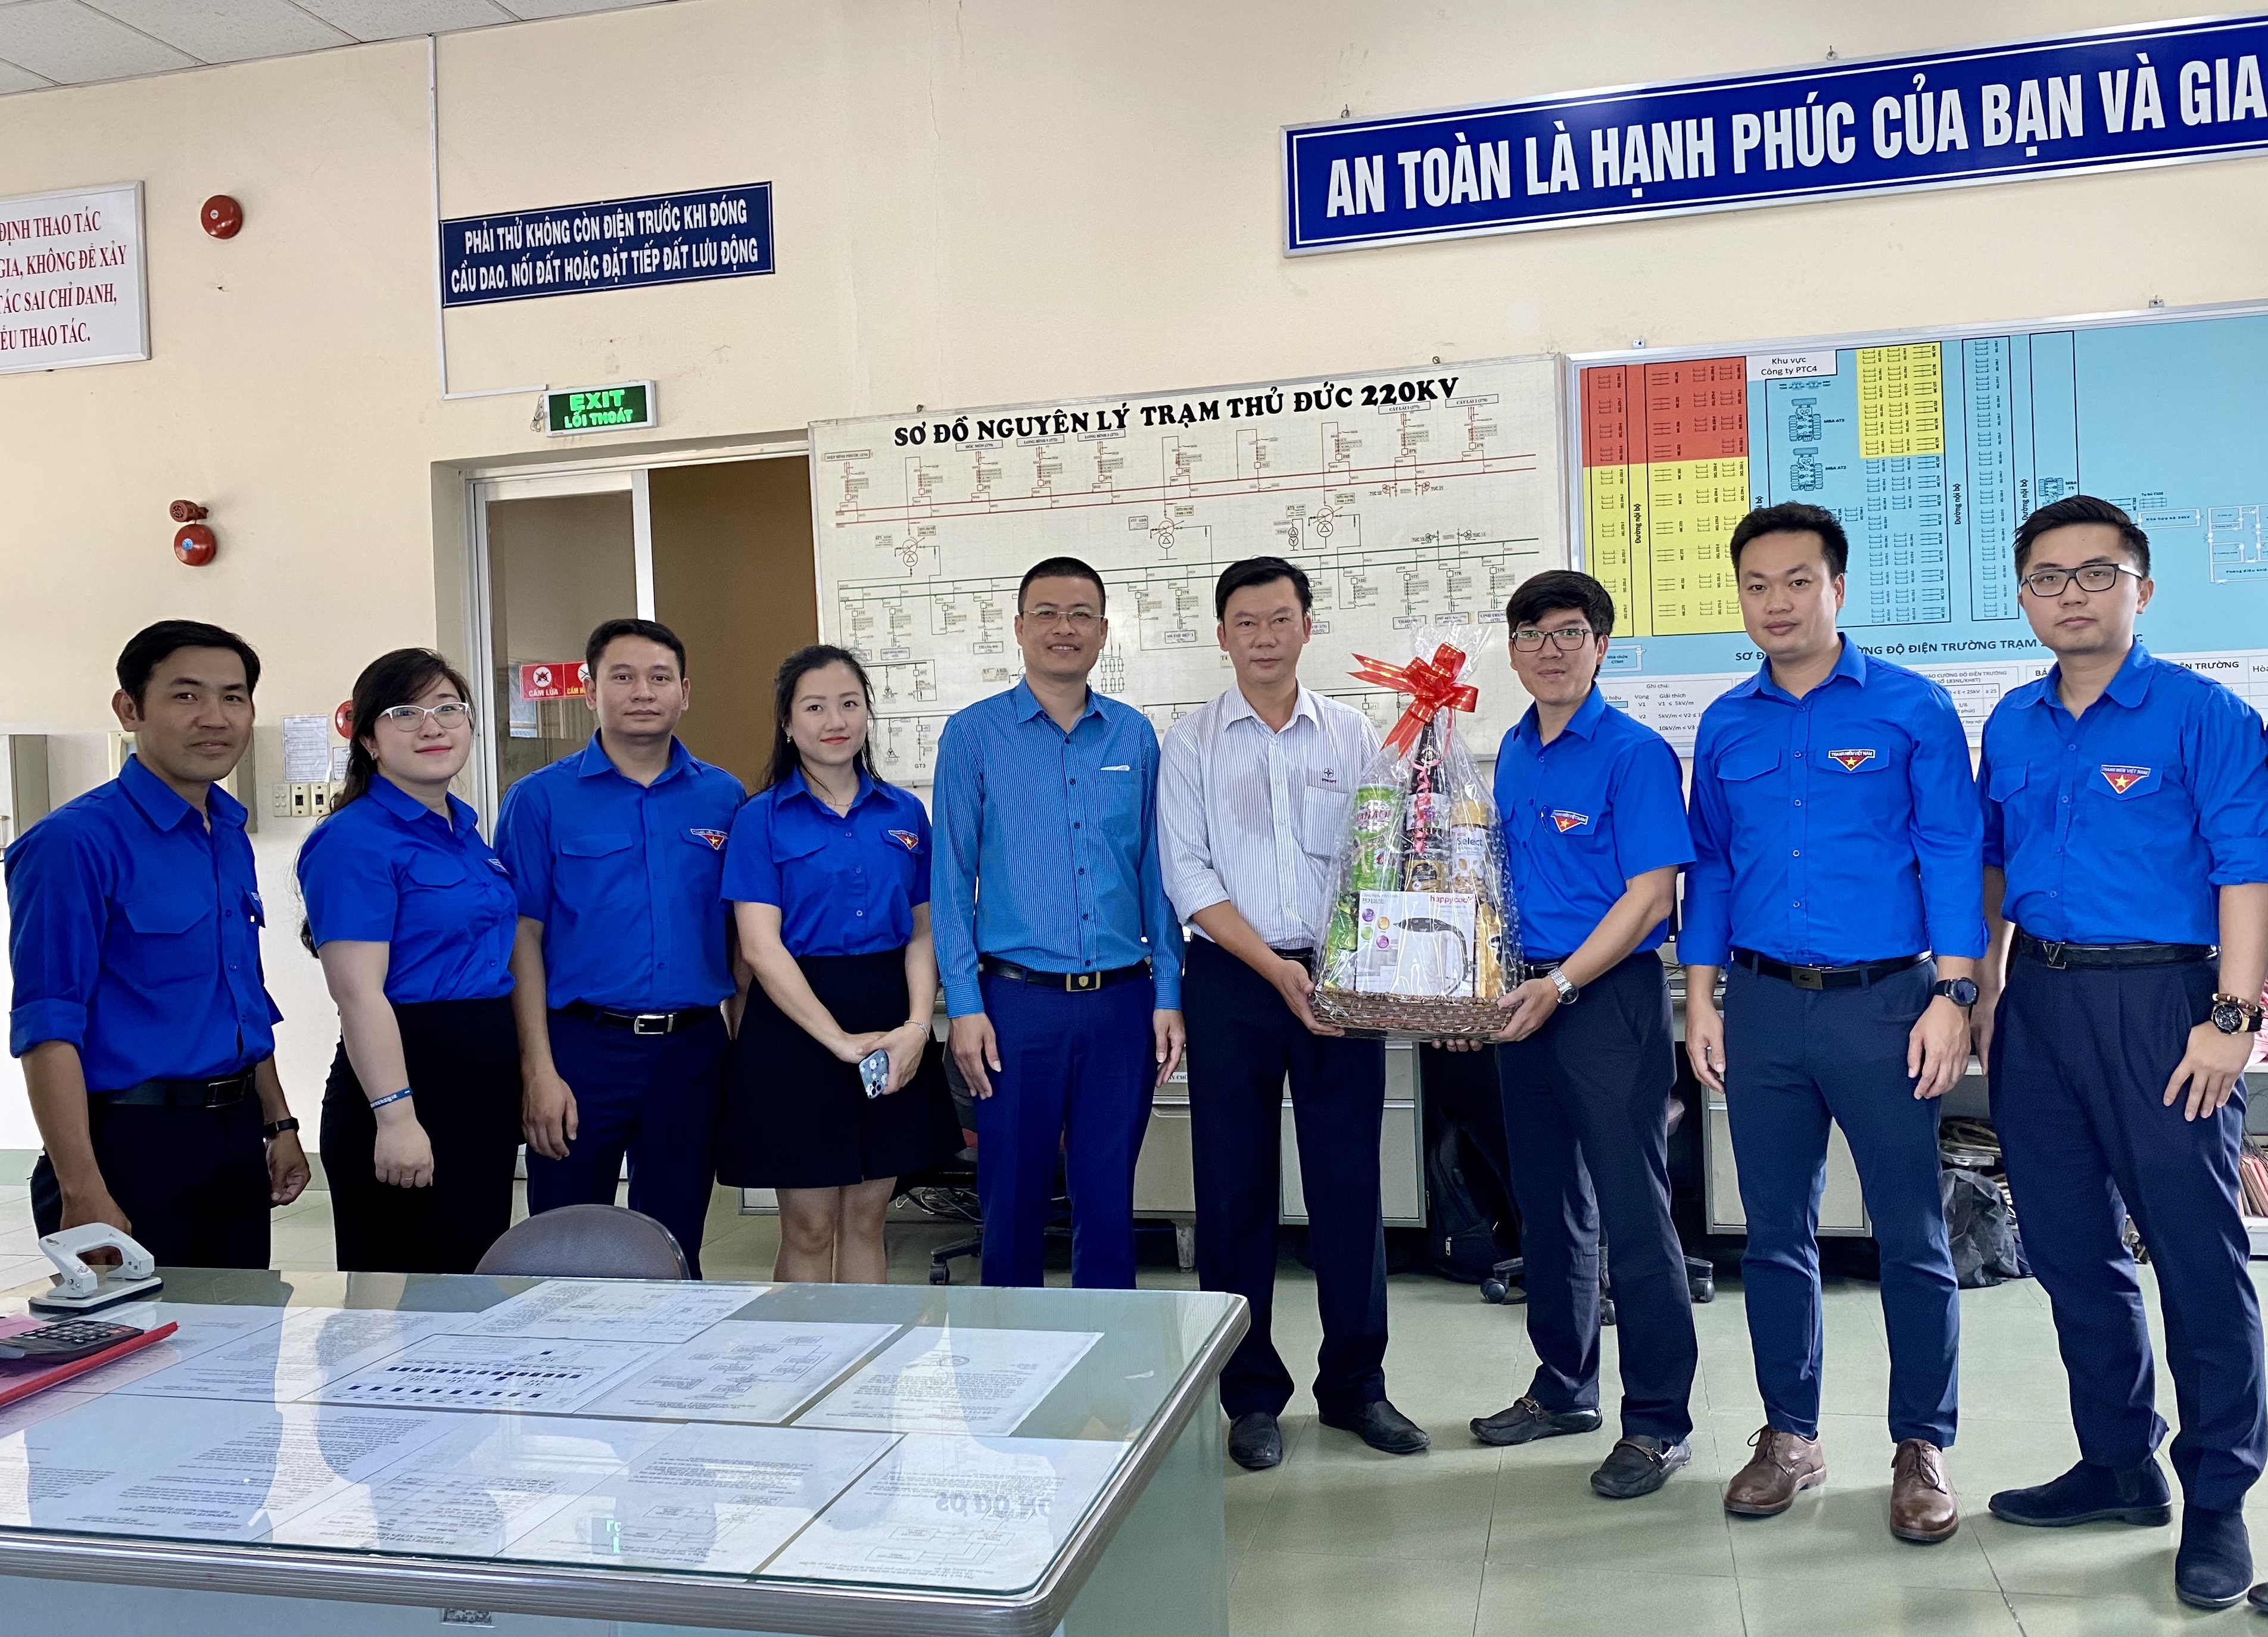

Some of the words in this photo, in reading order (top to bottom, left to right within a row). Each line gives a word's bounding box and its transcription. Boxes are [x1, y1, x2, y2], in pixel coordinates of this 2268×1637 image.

[1327, 155, 1385, 218] AN
[1398, 132, 1510, 210] TOÀN
[1525, 120, 1580, 197] LÀ
[1591, 117, 1715, 198] HẠNH
[1732, 92, 1856, 174] PHÚC
[1873, 73, 1968, 160] CỦA
[1982, 74, 2083, 158] BẠN
[2099, 52, 2165, 133] VÀ
[2180, 55, 2268, 127] GIA
[33, 214, 71, 238] THAO
[74, 207, 101, 232] TÁC
[465, 226, 494, 254] PHẢI
[497, 219, 524, 251] THỬ
[526, 216, 570, 248] KHÔNG
[573, 215, 601, 244] CÒN
[603, 208, 635, 244] ĐIỆN
[637, 201, 681, 235] TRƯỚC
[684, 204, 707, 230] KHI
[709, 194, 747, 227] ĐÓNG
[27, 247, 75, 275] KHÔNG
[79, 243, 96, 269] ĐỂ
[99, 240, 127, 267] XẢY
[451, 260, 476, 294] CẦU
[479, 267, 508, 290] DAO.
[512, 252, 533, 288] NỐI
[535, 254, 560, 285] ĐẤT
[564, 249, 600, 286] HOẶC
[602, 246, 627, 283] ĐẶT
[631, 240, 660, 275] TIẾP
[663, 237, 688, 272] ĐẤT
[692, 237, 717, 268] LƯU
[720, 233, 758, 271] ĐỘNG
[0, 288, 21, 314] ÁC
[24, 290, 45, 312] SAI
[48, 282, 73, 309] CHỈ
[76, 283, 117, 307] DANH,
[20, 326, 57, 348] THAO
[60, 318, 90, 344] TÁC.
[569, 388, 626, 412] EXIT
[565, 409, 588, 429] LỐI
[589, 408, 634, 426] THOÁT
[894, 419, 927, 447] SƠ
[933, 415, 970, 443] ĐỒ
[977, 409, 1089, 441] NGUYÊN
[1097, 403, 1131, 431] LÝ
[1140, 400, 1220, 429] TRẠM
[1227, 386, 1283, 418] THỦ
[1294, 381, 1353, 413] ĐỨC
[1360, 376, 1460, 406] 220KV
[1952, 483, 1961, 491] bộ
[2020, 479, 2028, 487] bộ
[1953, 493, 1961, 503] nội
[2020, 488, 2029, 498] nội
[1736, 650, 1753, 662] SƠ
[1886, 643, 1905, 656] ĐỘ
[1908, 642, 1937, 654] ĐIỆN
[1942, 639, 1996, 652] TRƯỜNG
[1999, 638, 2037, 650] TRẠM
[2195, 660, 2239, 669] TRƯỜNG
[528, 688, 544, 697] CẤM
[546, 687, 559, 696] LỬA
[567, 686, 579, 694] CẤM
[1457, 837, 1483, 846] Select
